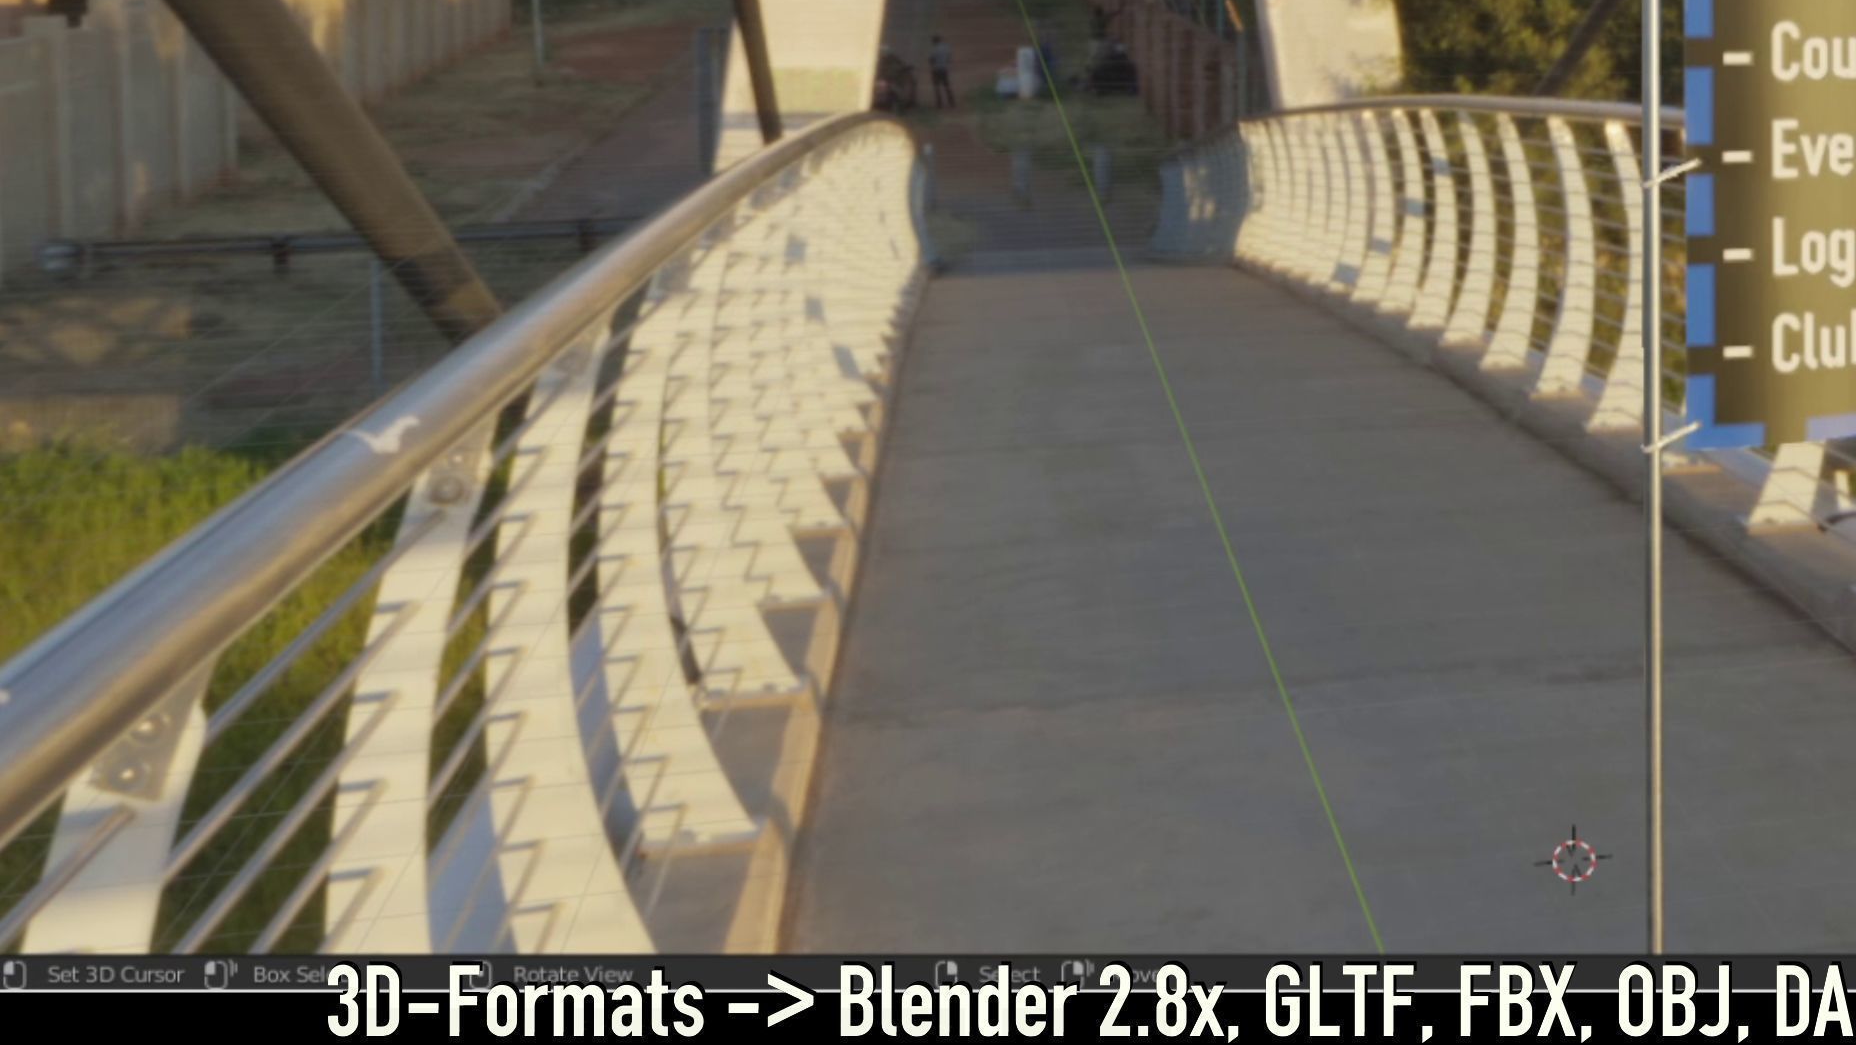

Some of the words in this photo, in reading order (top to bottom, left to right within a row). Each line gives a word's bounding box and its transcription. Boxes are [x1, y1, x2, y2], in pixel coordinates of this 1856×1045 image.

[48, 966, 80, 984] Set
[86, 966, 114, 984] 3D
[120, 966, 186, 984] Cursor
[253, 966, 291, 983] Box
[513, 966, 579, 983] Rotate
[584, 966, 634, 983] View
[979, 965, 1041, 983] Seect
